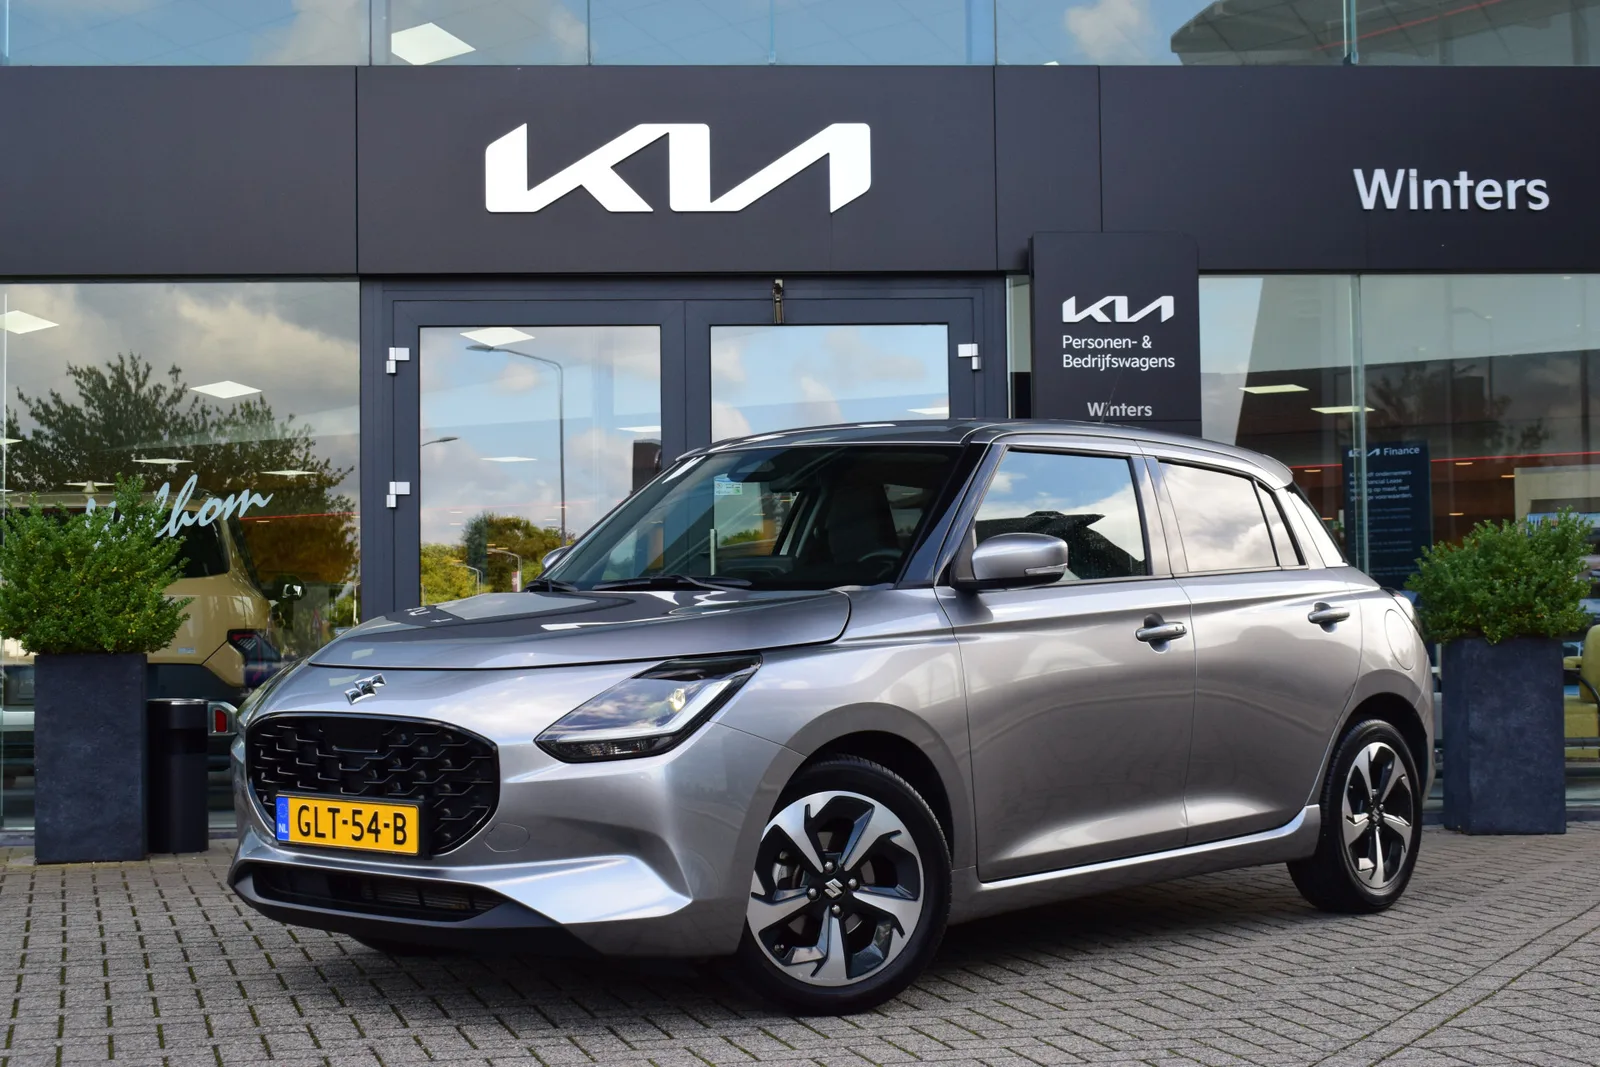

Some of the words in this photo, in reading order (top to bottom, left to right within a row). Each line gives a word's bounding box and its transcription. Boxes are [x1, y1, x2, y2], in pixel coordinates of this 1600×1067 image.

[485, 122, 872, 213] KIA
[1353, 168, 1550, 211] Winters
[1062, 295, 1174, 323] KIA
[1062, 335, 1138, 349] Personen-
[1142, 335, 1152, 349] &
[1062, 354, 1175, 371] Bedrijfswagens
[1383, 447, 1420, 456] Finance
[278, 823, 289, 834] NL
[297, 804, 407, 845] GLT-54-B
